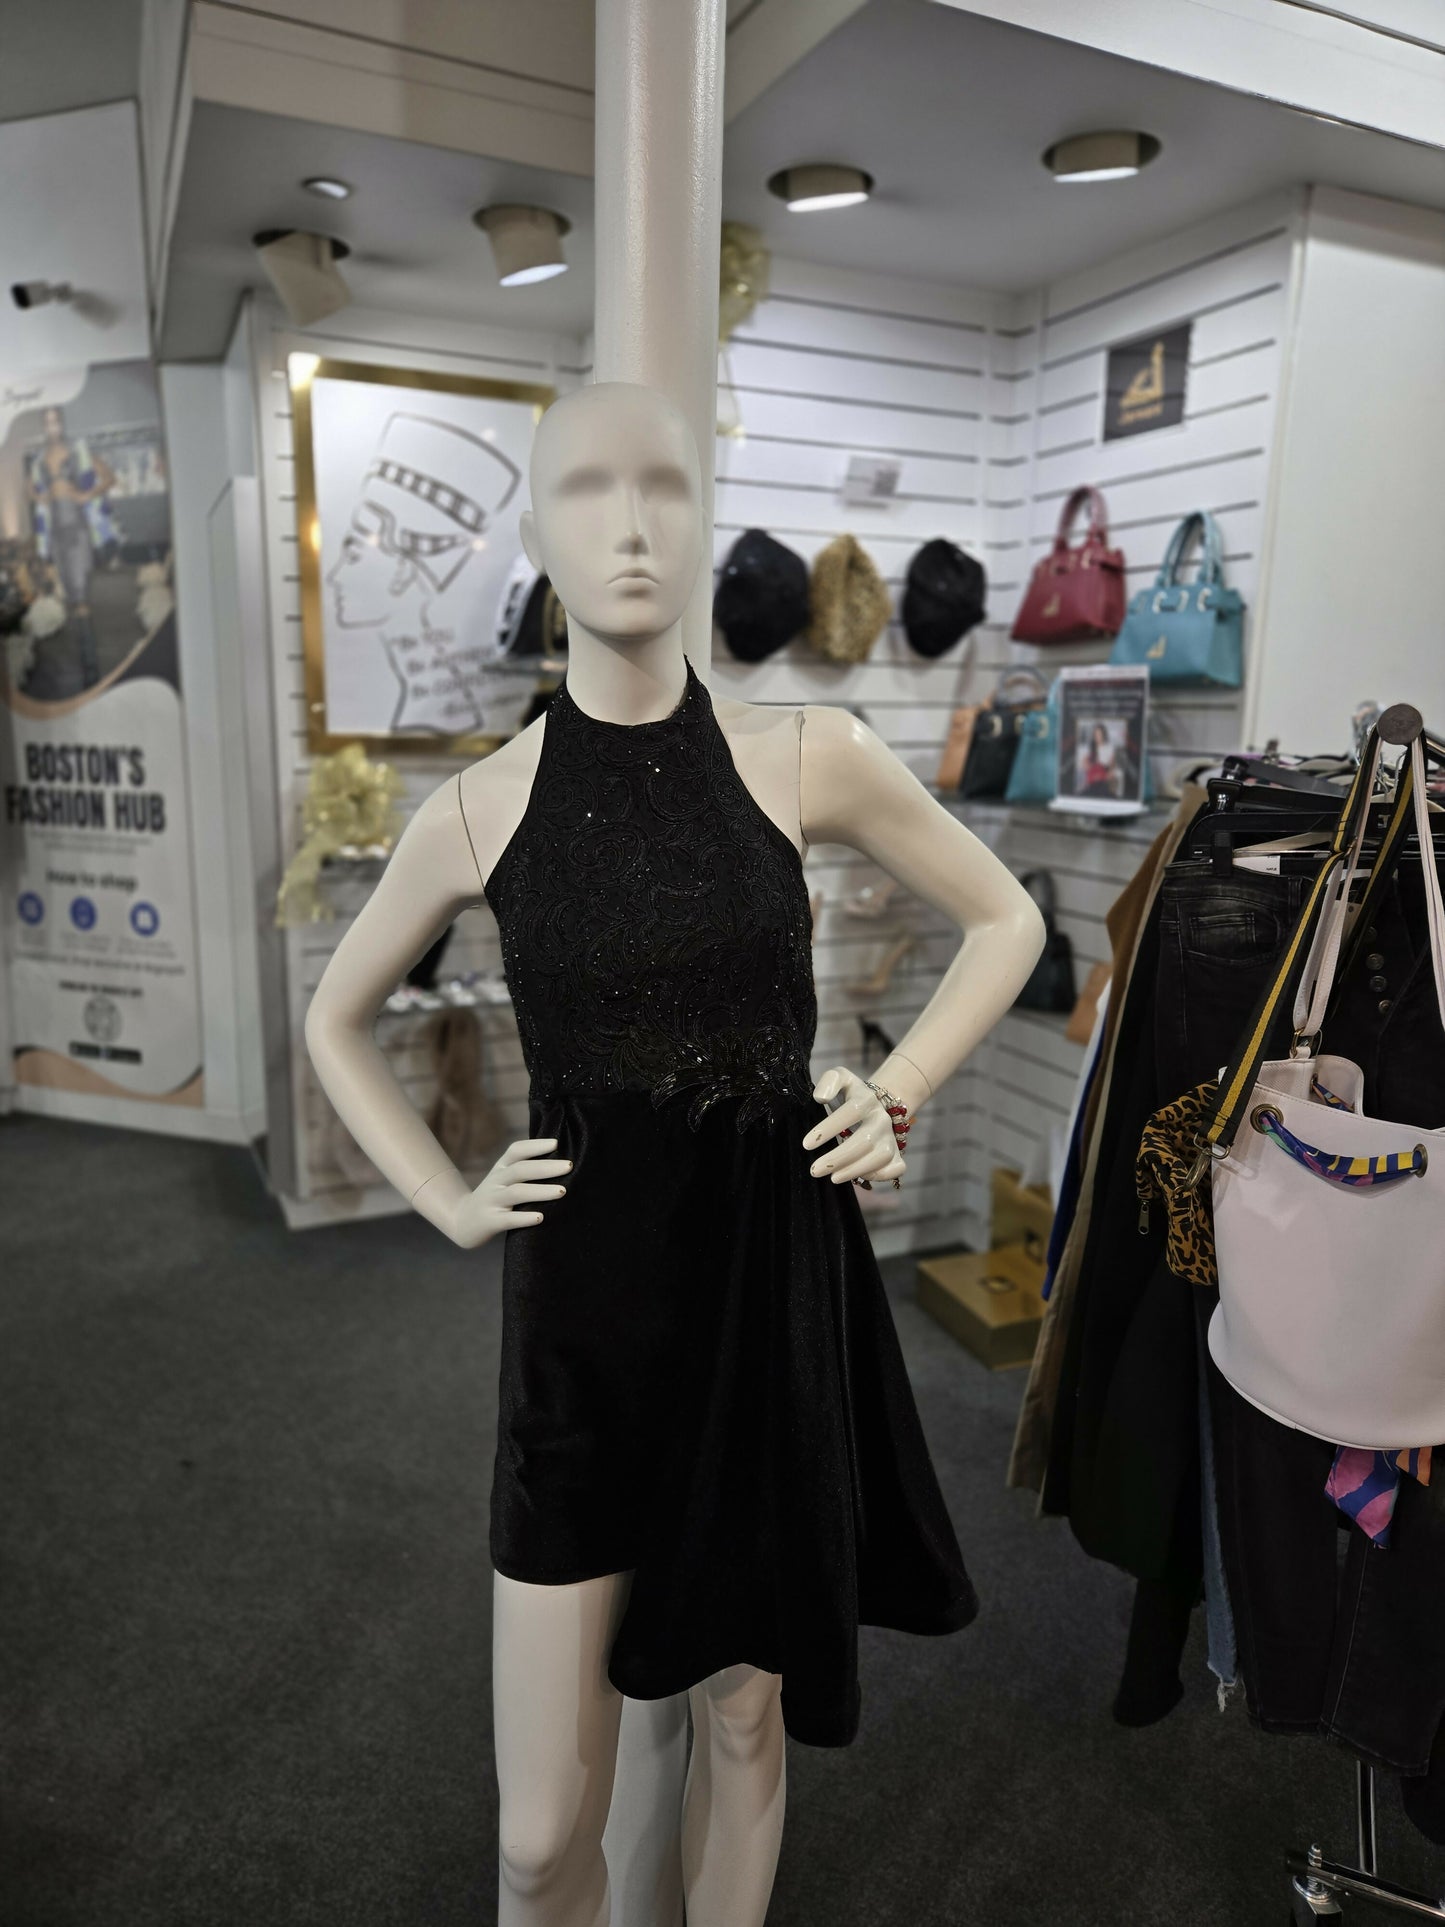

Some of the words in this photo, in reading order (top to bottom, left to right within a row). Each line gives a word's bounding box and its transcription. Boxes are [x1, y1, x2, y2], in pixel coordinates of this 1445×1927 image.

[25, 743, 145, 787] BOSTON'S
[6, 785, 106, 829] FASHION
[114, 792, 166, 834] HUB
